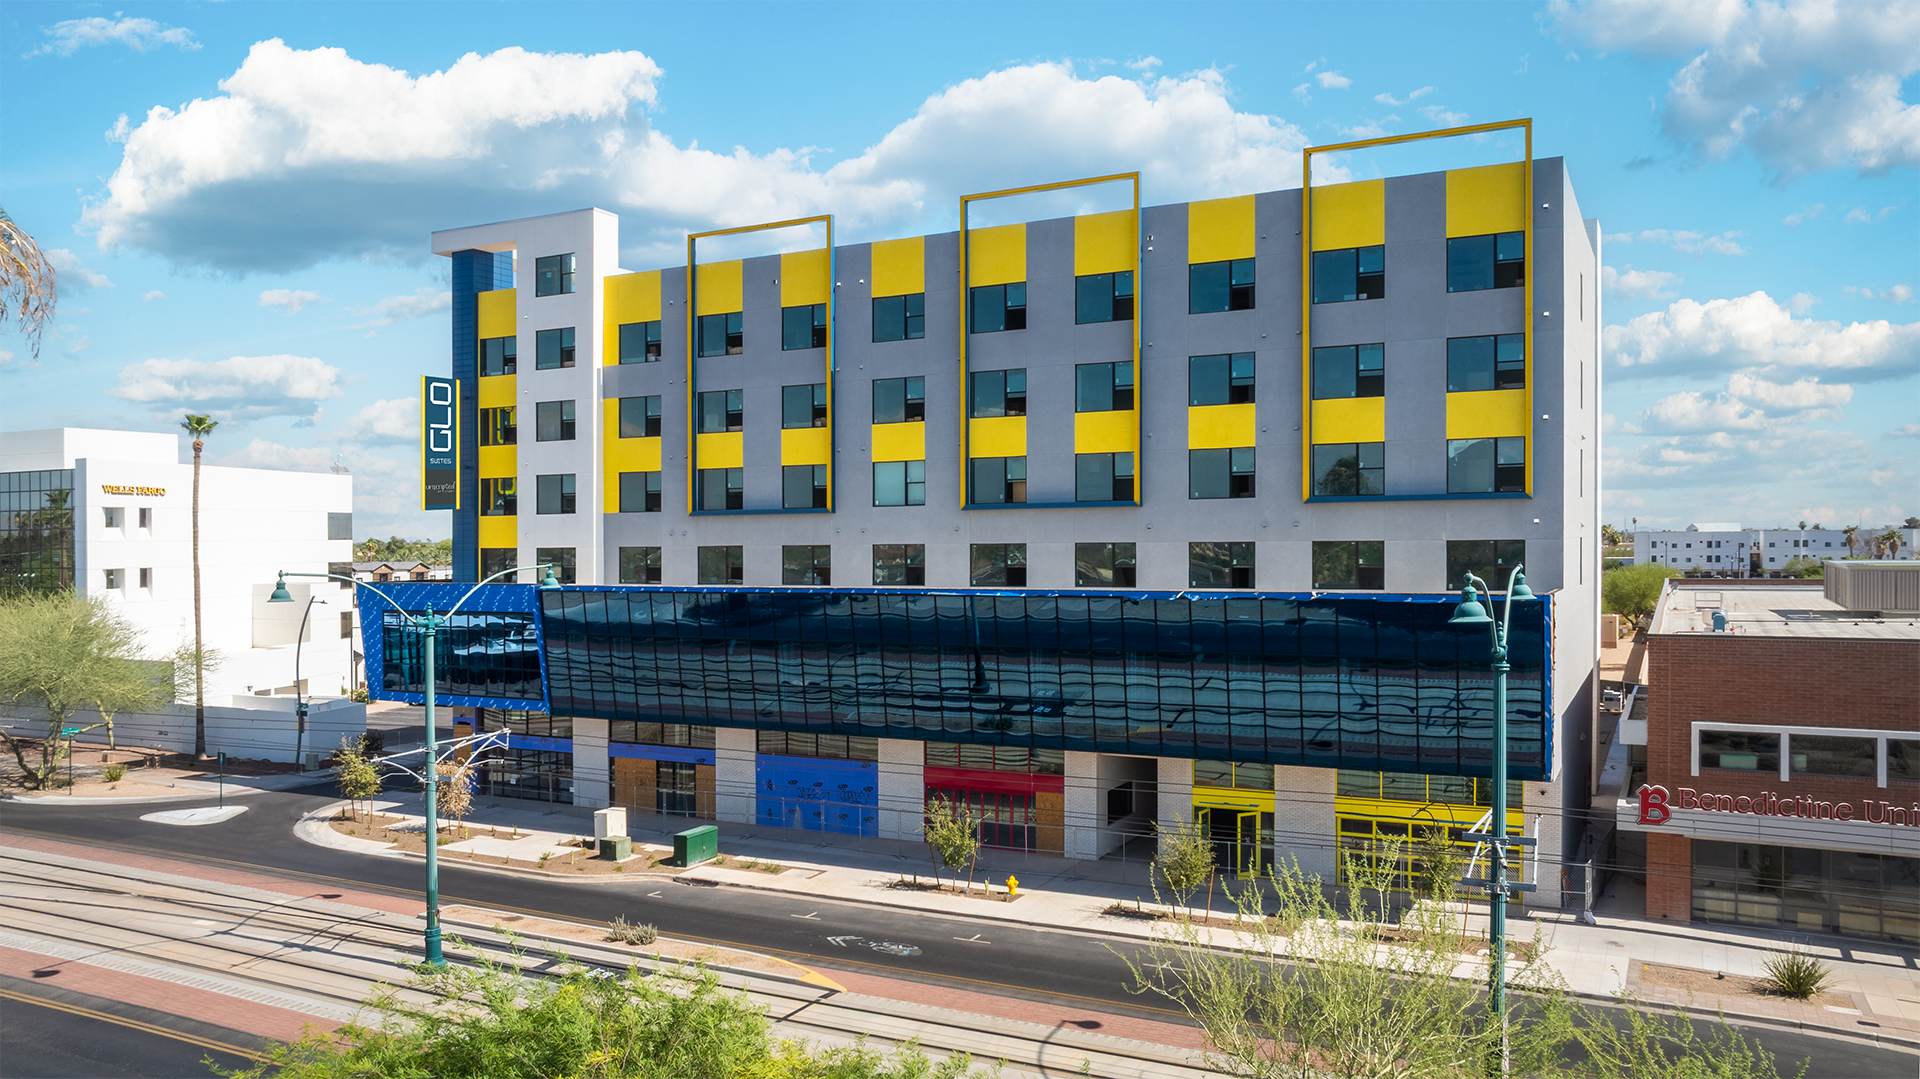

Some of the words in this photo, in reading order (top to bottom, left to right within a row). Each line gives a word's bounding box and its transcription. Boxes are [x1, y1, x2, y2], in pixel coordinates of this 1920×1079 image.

[430, 382, 451, 452] GLO
[102, 485, 135, 495] WELLS
[136, 487, 166, 496] FARGO
[1635, 783, 1672, 826] B
[1677, 787, 1854, 821] Benedictine
